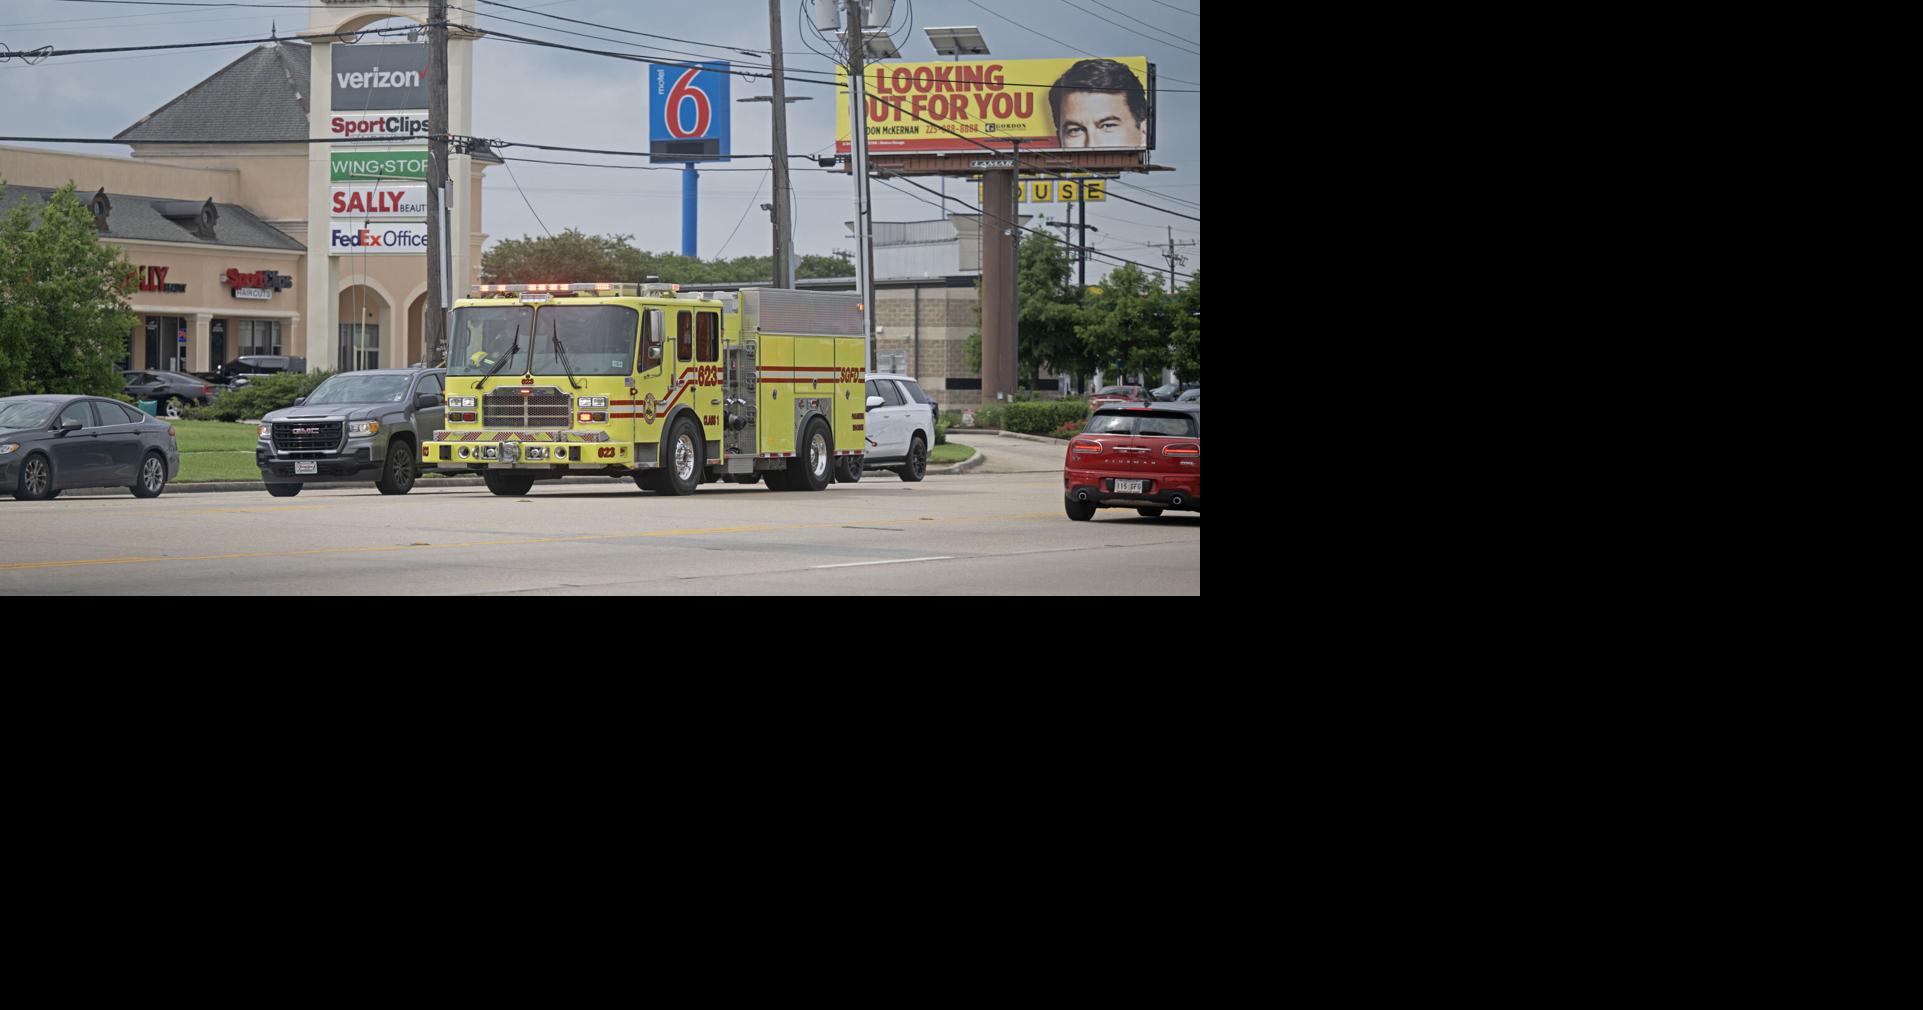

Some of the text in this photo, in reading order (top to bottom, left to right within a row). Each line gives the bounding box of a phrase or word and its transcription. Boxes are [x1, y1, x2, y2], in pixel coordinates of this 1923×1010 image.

[337, 67, 419, 89] verizon
[656, 69, 664, 94] motel
[877, 64, 1004, 94] LOOKING
[664, 64, 712, 139] 6
[912, 93, 968, 121] FOR
[973, 92, 1033, 119] YOU
[865, 126, 880, 135] DON
[882, 125, 919, 135] McKERNAN
[332, 191, 426, 213] SALLY BEAUT
[332, 229, 428, 247] FedEx Office
[697, 365, 717, 386] 623
[292, 427, 320, 435] GMC
